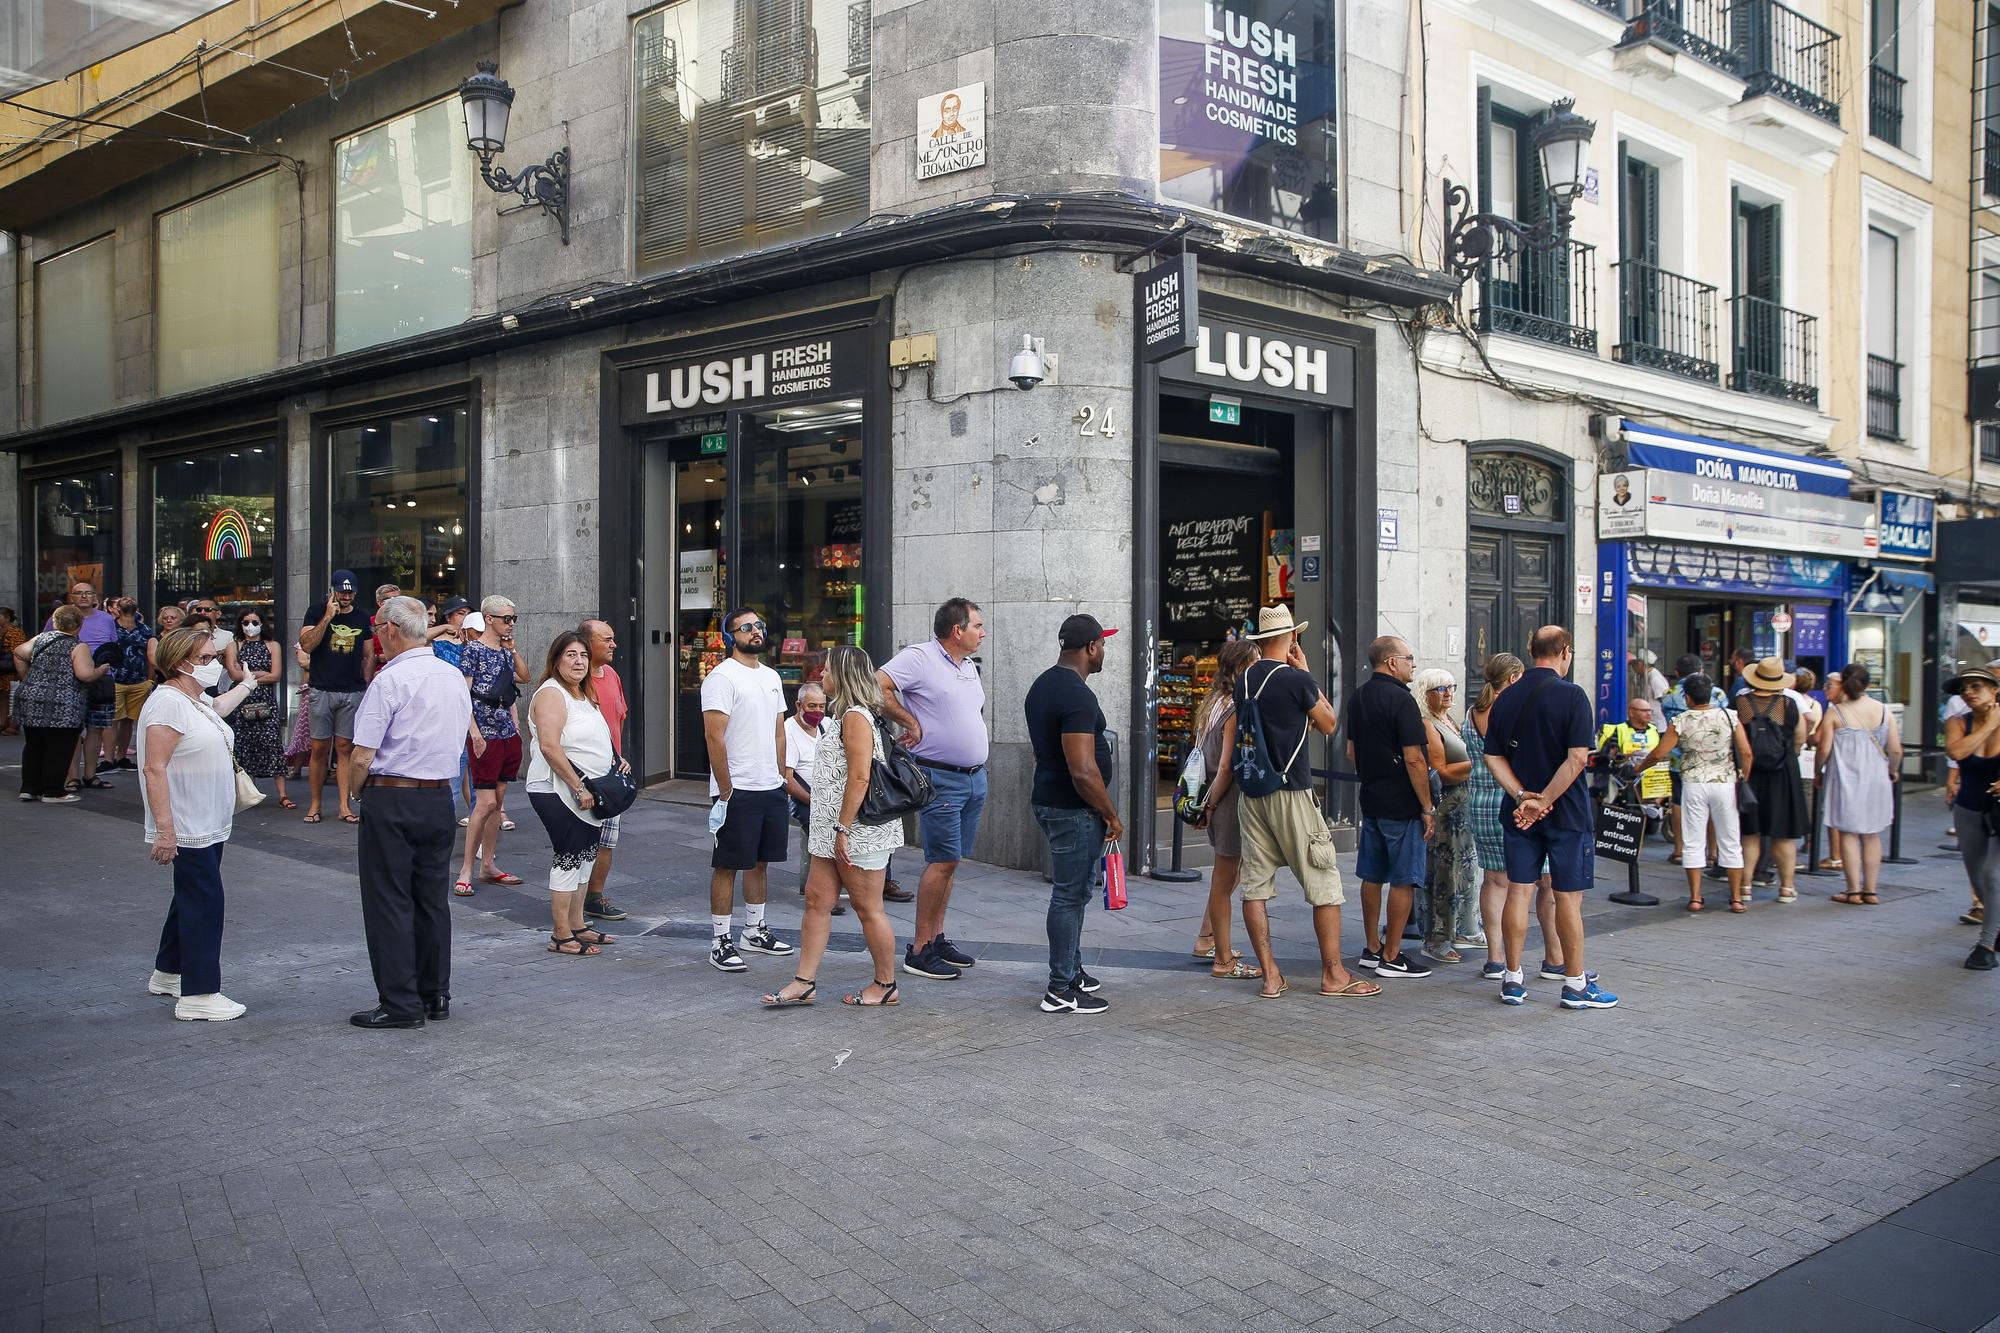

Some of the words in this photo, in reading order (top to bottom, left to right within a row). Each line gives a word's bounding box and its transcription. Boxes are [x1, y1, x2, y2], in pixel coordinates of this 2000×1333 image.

[1204, 1, 1297, 68] LUSH
[1205, 43, 1297, 104] FRESH
[1205, 78, 1297, 125] HANDMADE
[1205, 102, 1297, 147] COSMETICS
[918, 138, 983, 165] MESONERO
[929, 134, 956, 148] CALLE
[963, 131, 973, 139] DE
[922, 153, 979, 177] ROMANOS
[1145, 271, 1179, 305] LUSH
[1146, 293, 1179, 323] FRESH
[1146, 311, 1180, 335] HANDMADE
[1146, 323, 1180, 345] COSMETICS
[772, 341, 832, 369] FRESH
[1195, 325, 1328, 395] LUSH
[646, 353, 765, 413] LUSH
[772, 362, 832, 383] HANDMADE
[772, 376, 832, 396] COSMETICS
[1079, 404, 1116, 438] 24
[1695, 457, 1735, 481] DOÑA
[1738, 465, 1800, 492] MANOLITA
[1692, 482, 1721, 505] Doña
[1721, 486, 1766, 511] Manolita
[1177, 533, 1210, 549] DESDE
[1212, 531, 1234, 546] 2009
[1879, 522, 1932, 550] BACALAO
[1604, 808, 1641, 822] Despejen
[1616, 822, 1624, 830] la
[1603, 830, 1634, 842] entrada
[1613, 844, 1638, 856] favor!
